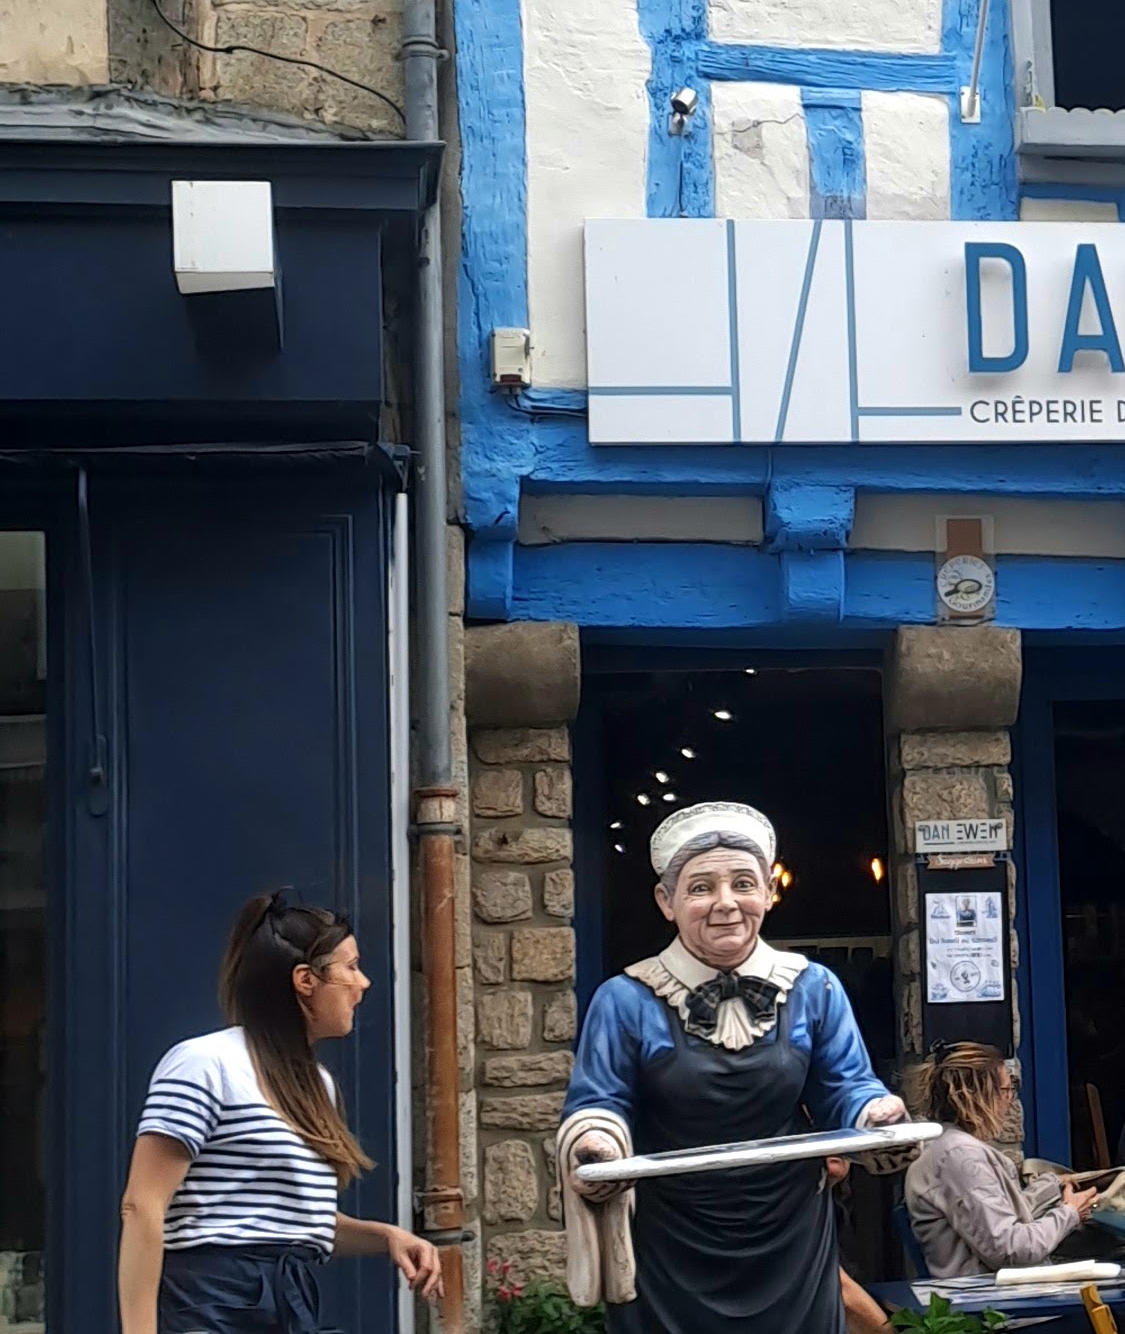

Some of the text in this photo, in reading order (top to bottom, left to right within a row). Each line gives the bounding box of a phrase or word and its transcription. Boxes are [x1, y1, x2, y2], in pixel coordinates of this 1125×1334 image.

[969, 394, 1104, 425] CRÊPERIE
[922, 822, 998, 841] DAN EWEN
